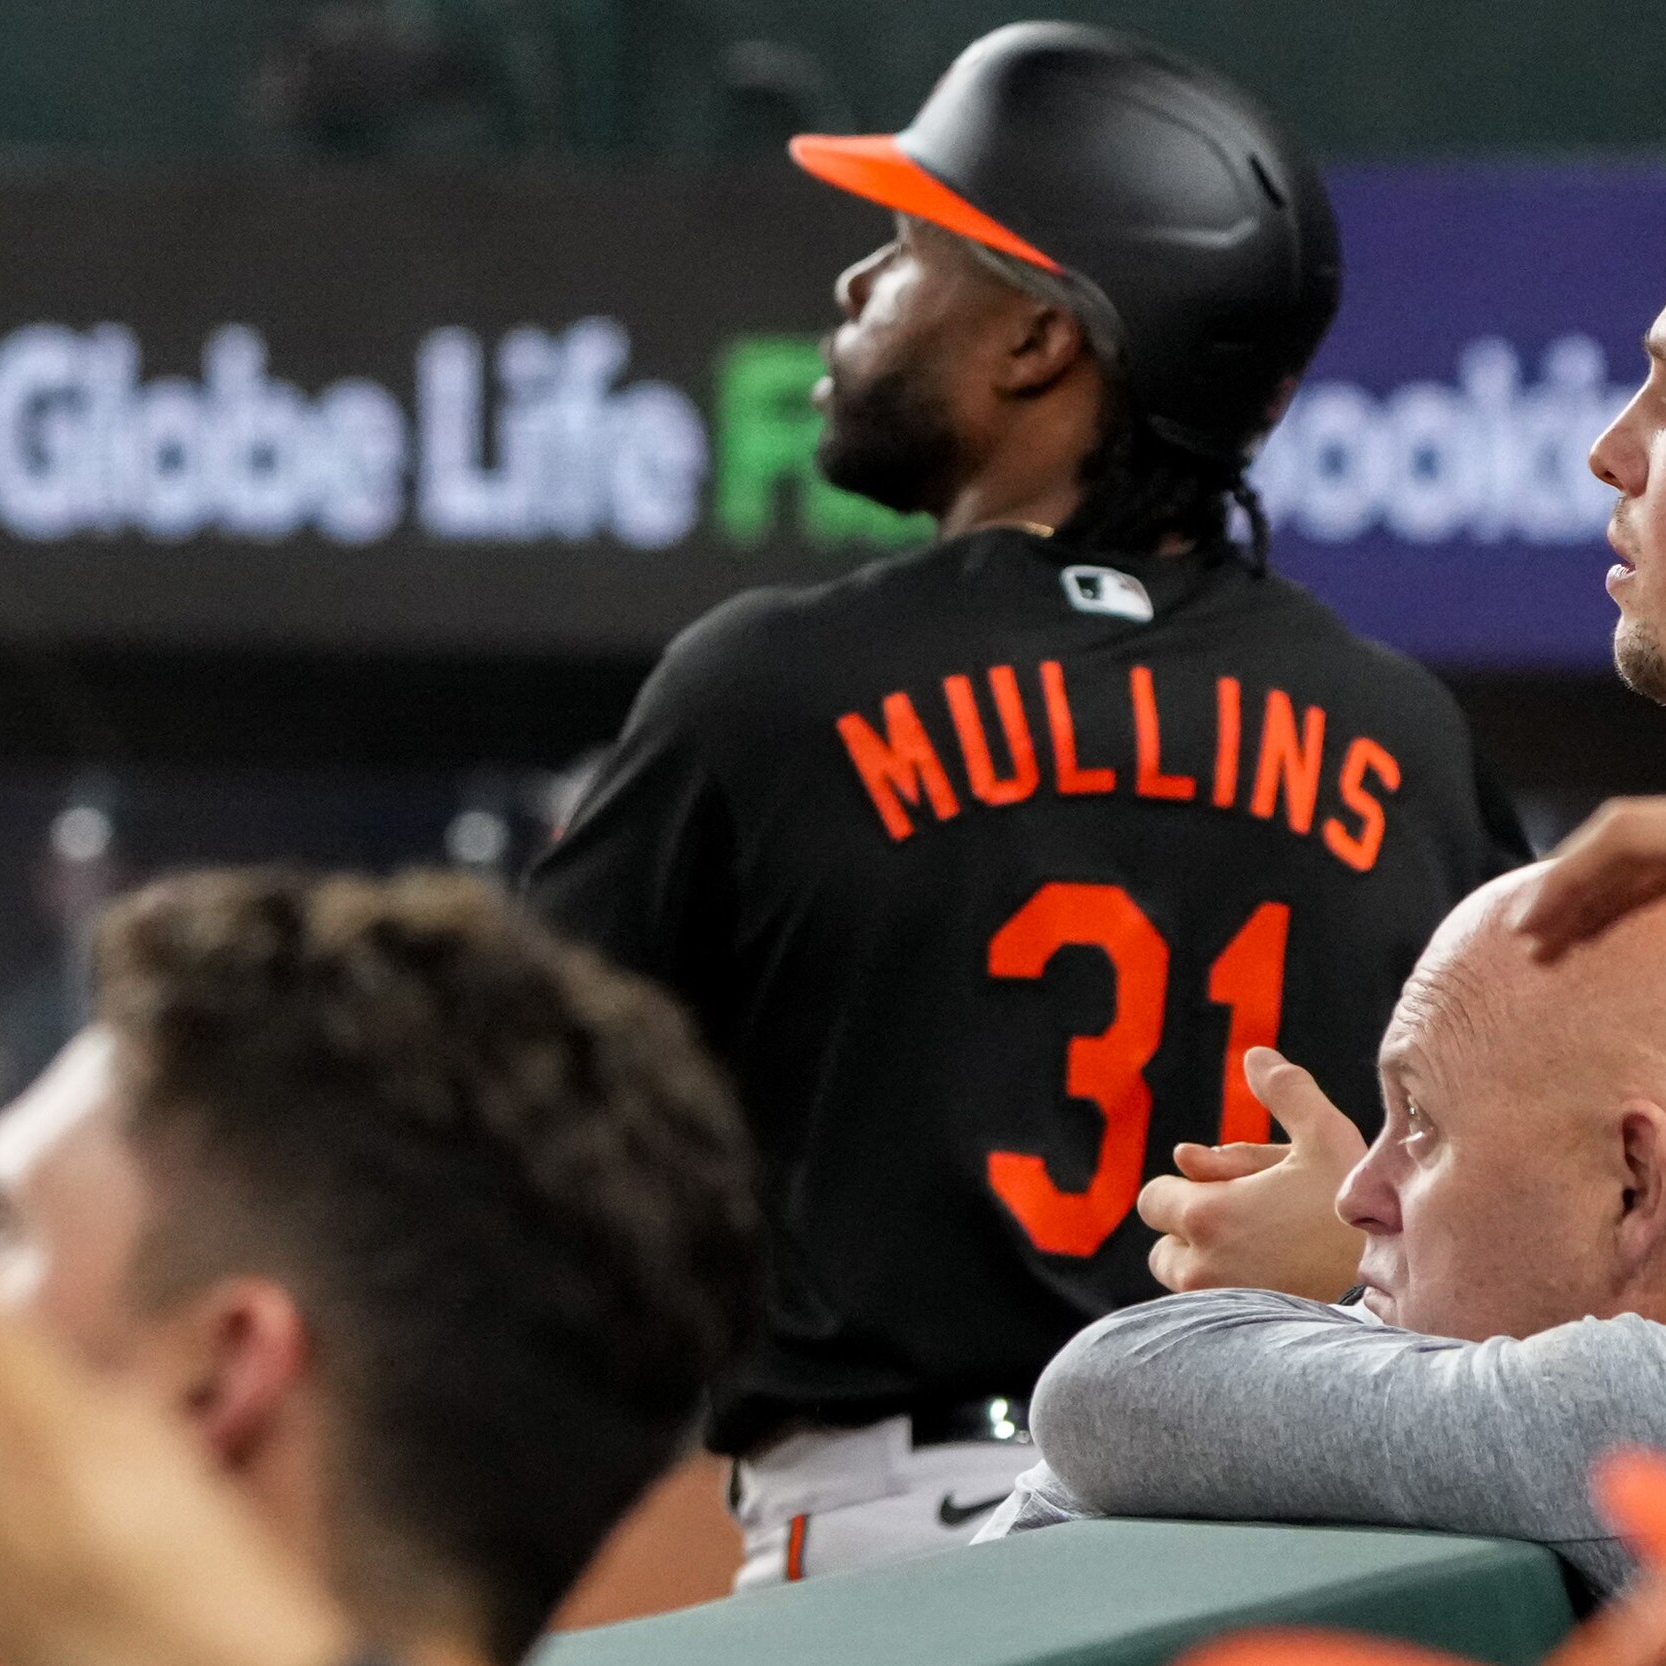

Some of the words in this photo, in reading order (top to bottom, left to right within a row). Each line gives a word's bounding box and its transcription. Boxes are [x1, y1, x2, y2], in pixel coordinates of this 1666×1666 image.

[417, 316, 708, 547] Life
[836, 660, 1401, 873] MULLINS
[987, 881, 1291, 1258] 31
